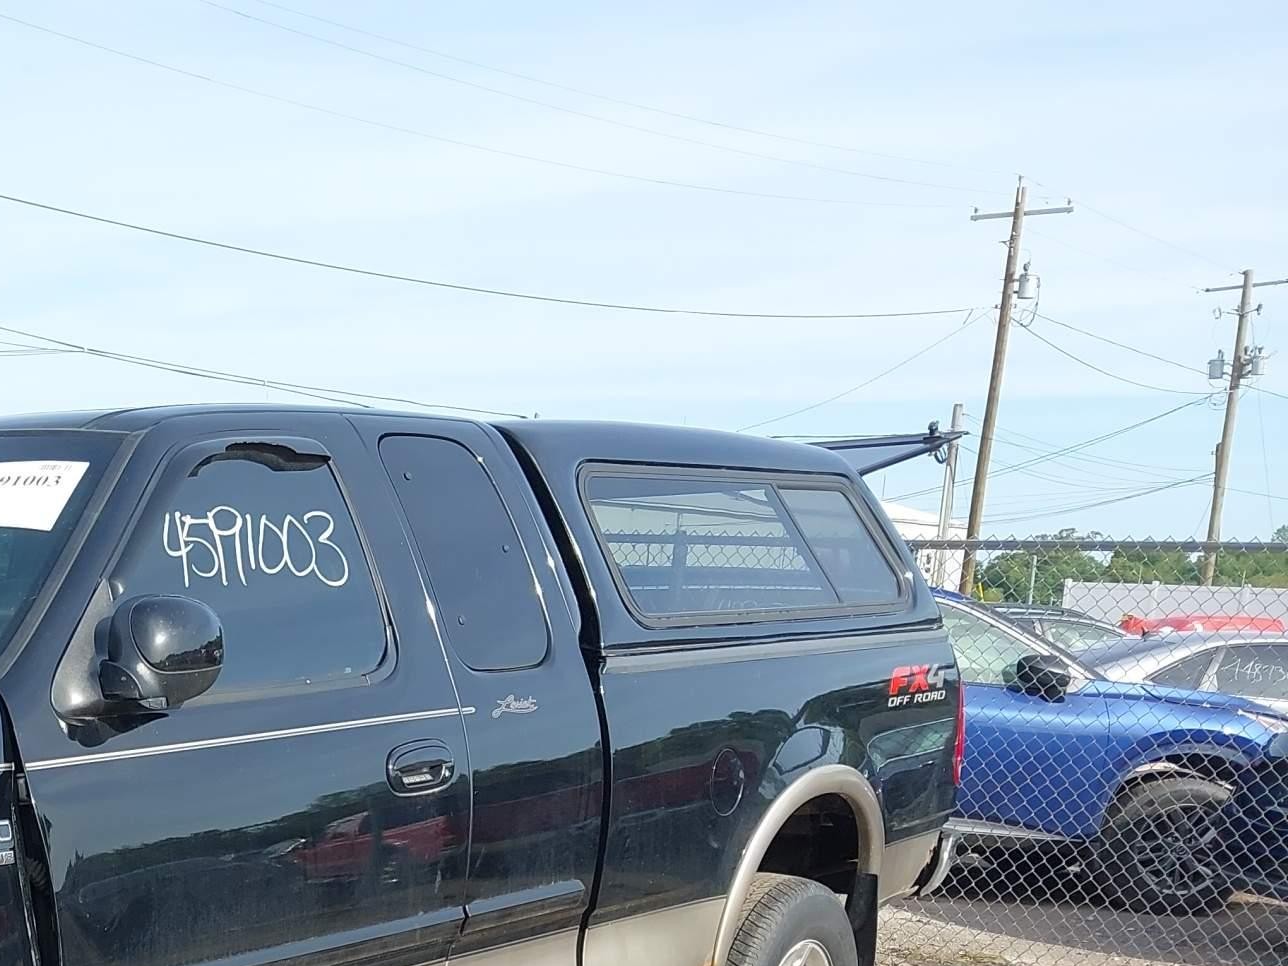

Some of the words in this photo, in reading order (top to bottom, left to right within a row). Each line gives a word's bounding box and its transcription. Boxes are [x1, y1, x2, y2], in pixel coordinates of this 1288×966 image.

[888, 663, 945, 695] FX4
[887, 694, 912, 708] OFF
[913, 690, 946, 704] ROAD
